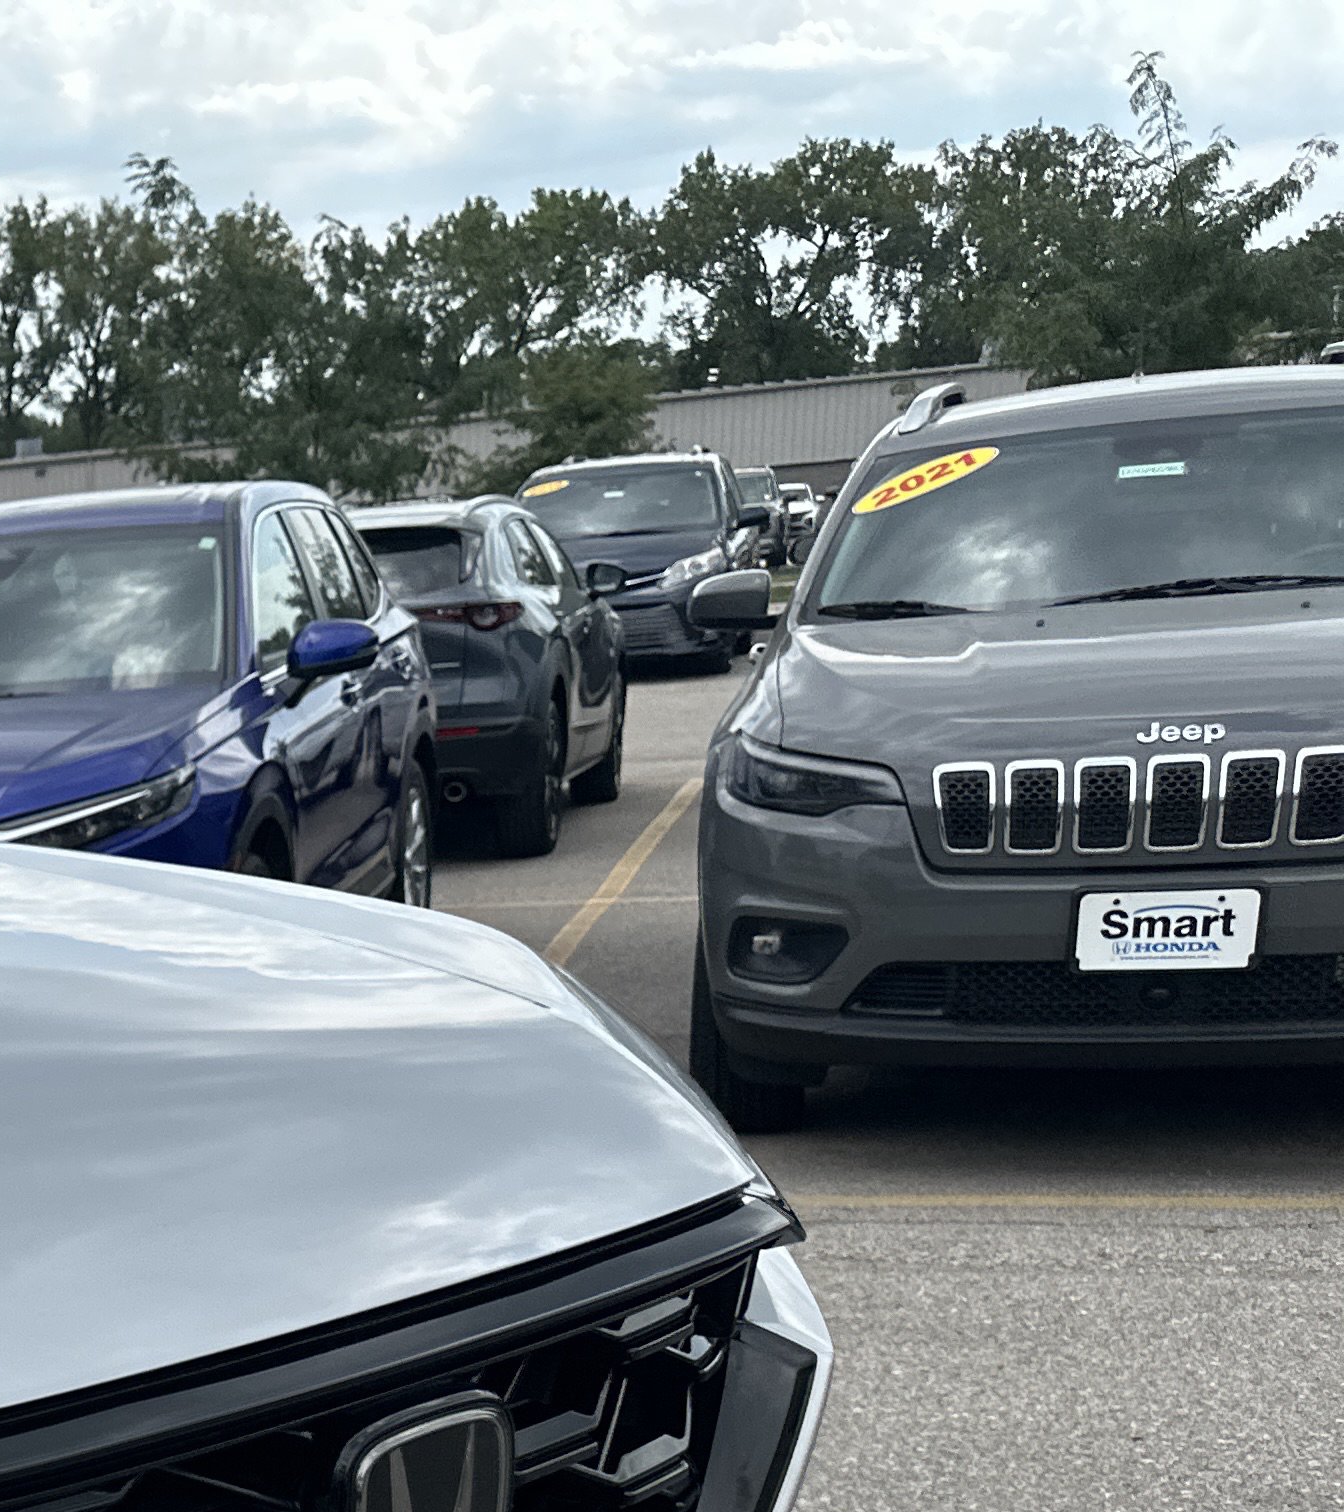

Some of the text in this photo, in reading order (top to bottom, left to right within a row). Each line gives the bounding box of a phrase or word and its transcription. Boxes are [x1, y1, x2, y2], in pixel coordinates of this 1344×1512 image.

[871, 452, 977, 508] 2021
[1136, 722, 1226, 744] Jeep
[1099, 908, 1237, 940] Smart
[1133, 941, 1221, 954] HONDA
